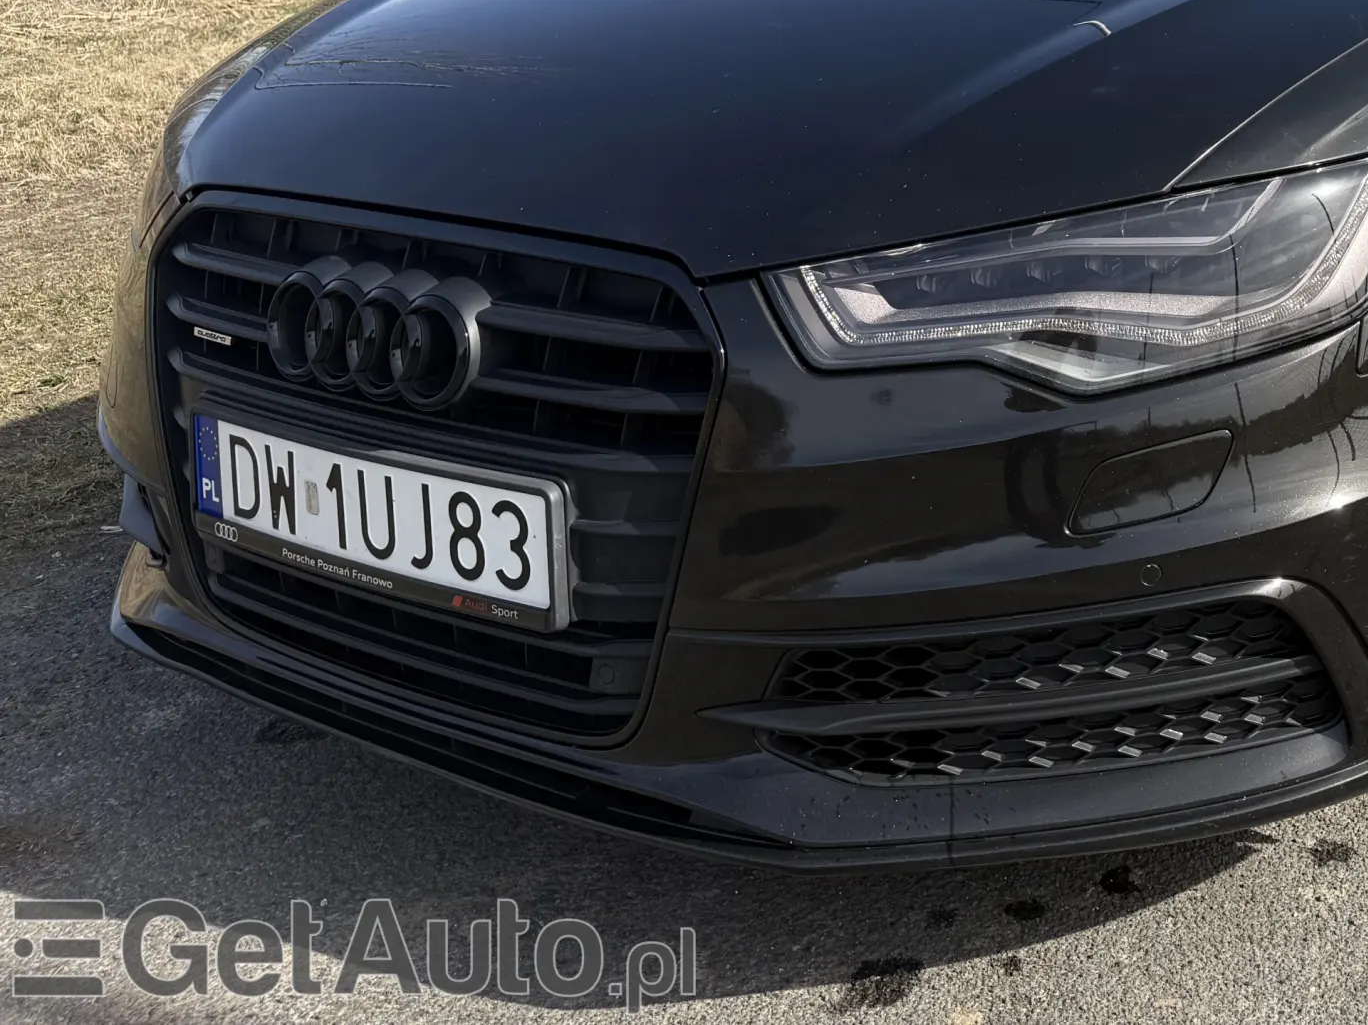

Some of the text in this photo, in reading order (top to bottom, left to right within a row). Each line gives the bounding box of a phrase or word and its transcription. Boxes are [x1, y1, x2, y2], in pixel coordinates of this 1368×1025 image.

[202, 477, 220, 503] PL
[229, 433, 532, 591] DW 1UJ83
[282, 547, 393, 589] Porsche Poznań Franowo
[464, 598, 519, 620] Audi Sport
